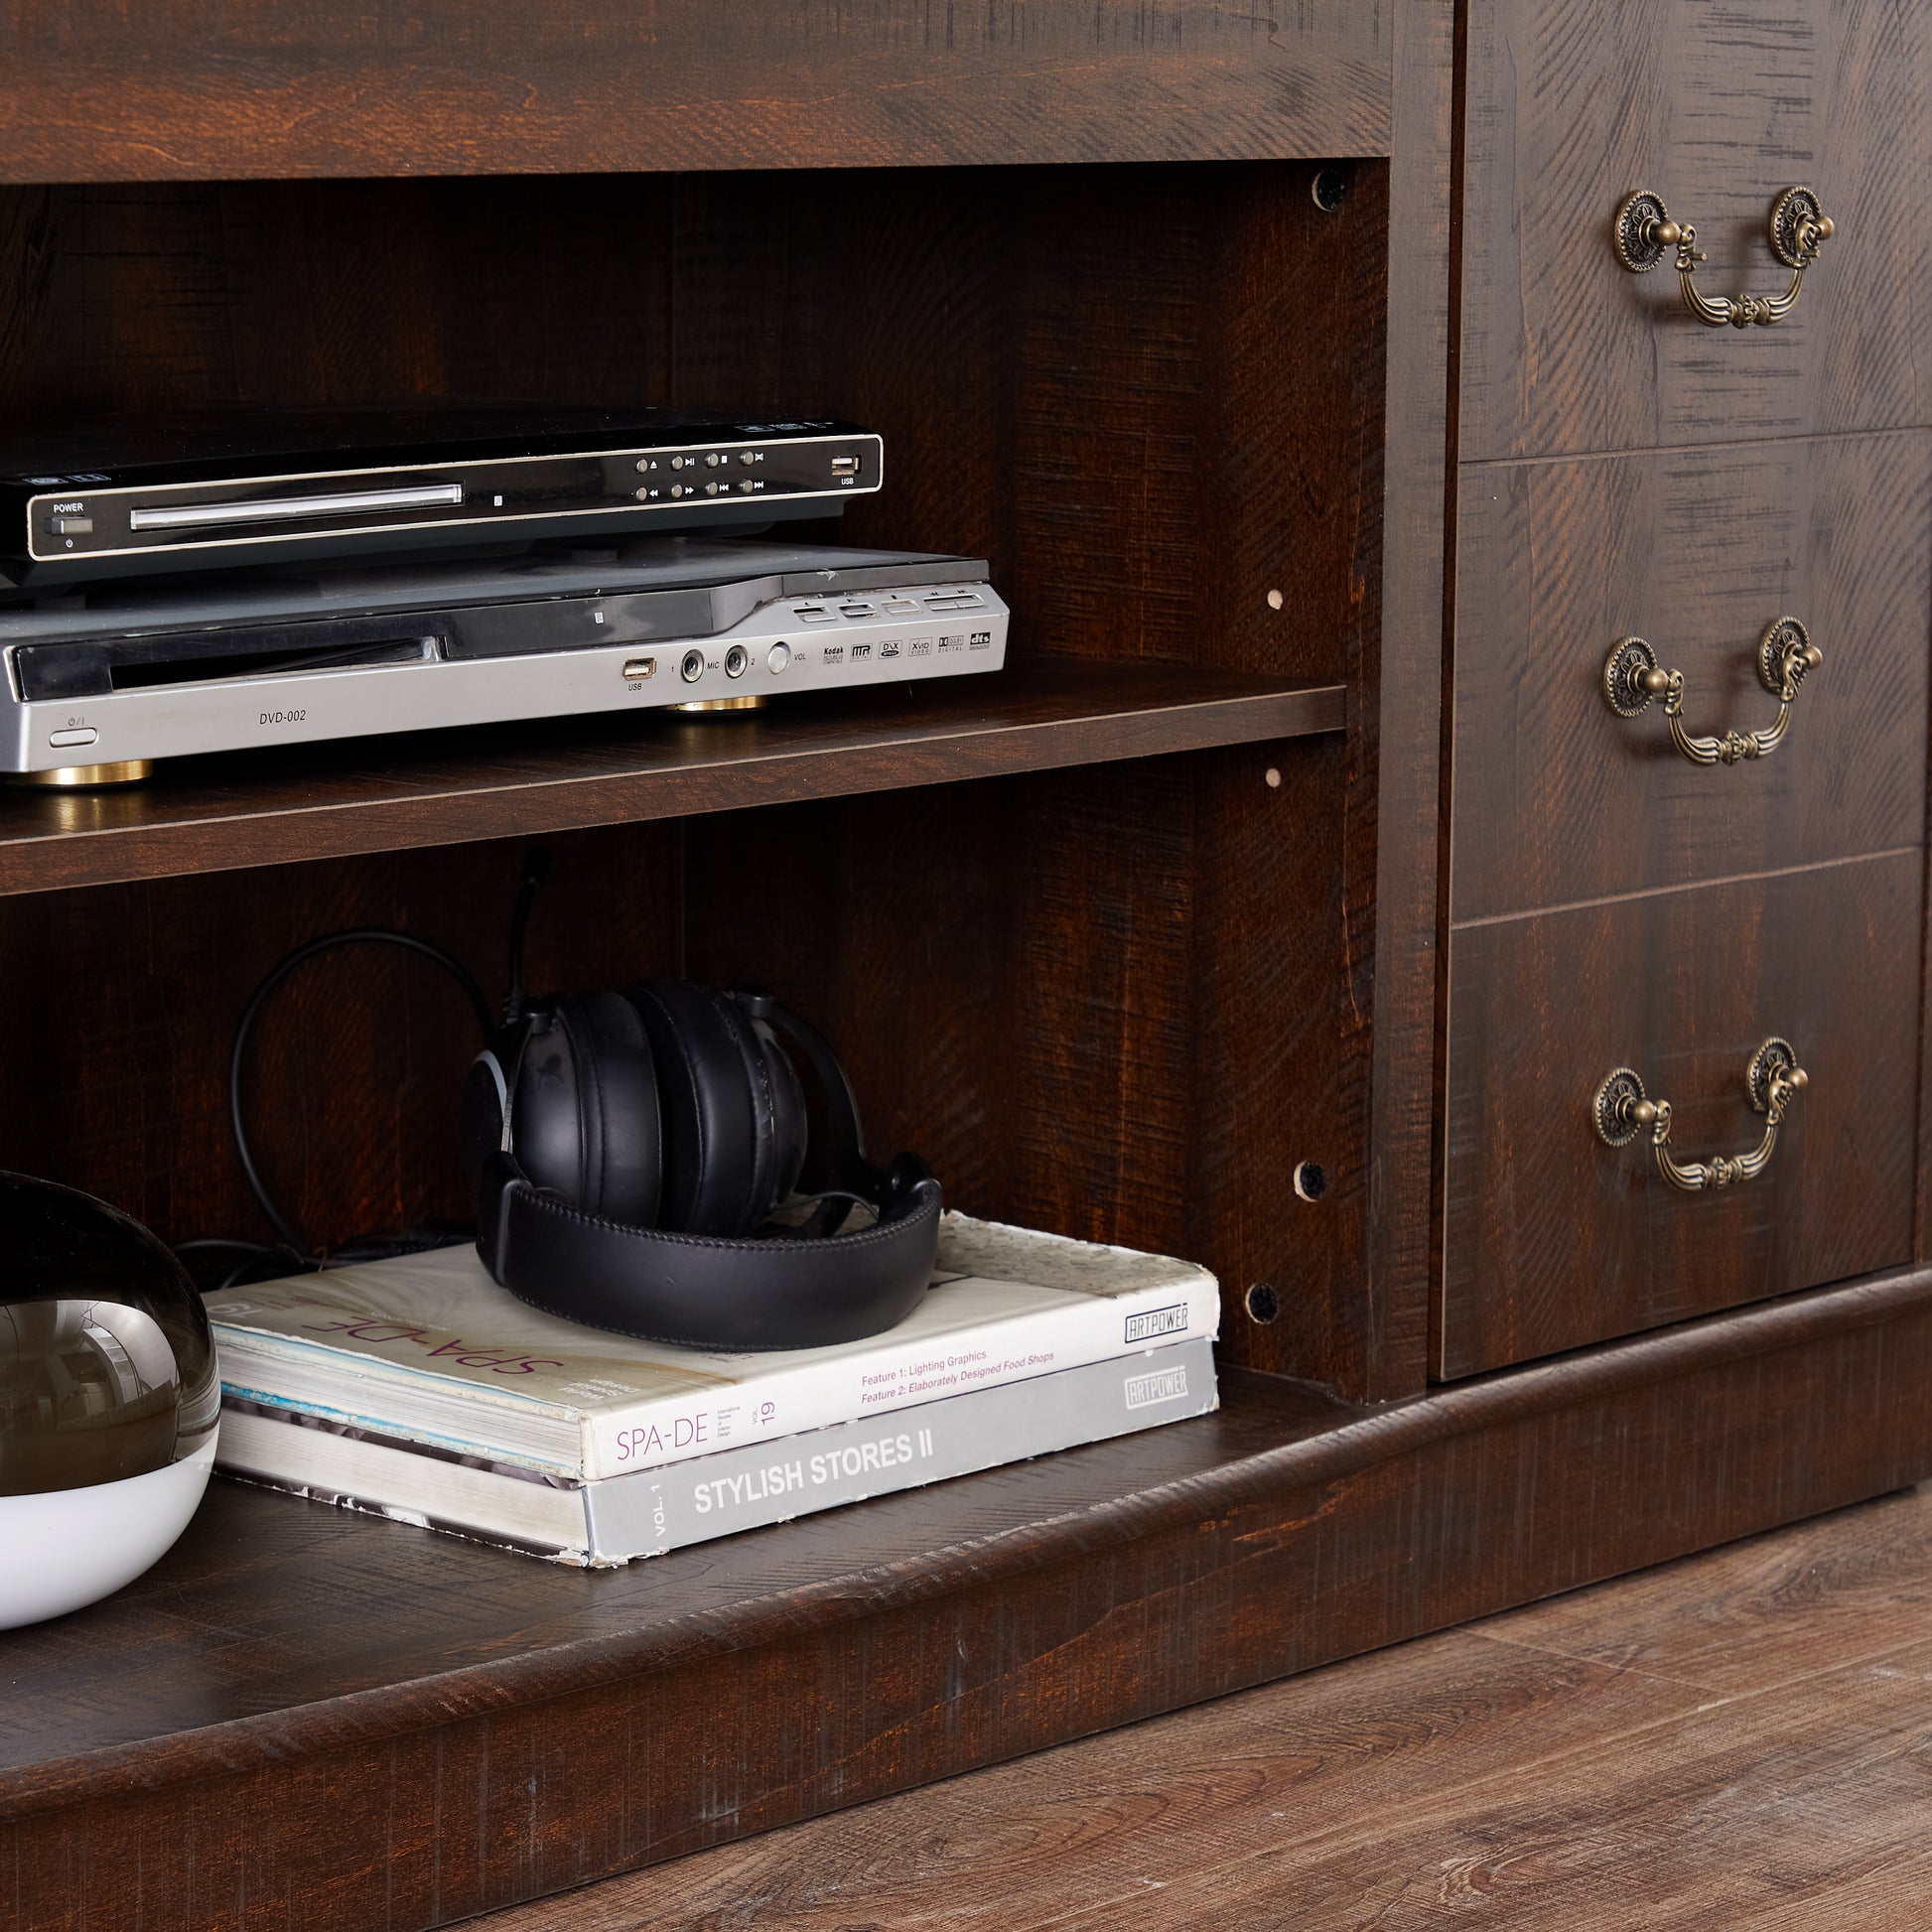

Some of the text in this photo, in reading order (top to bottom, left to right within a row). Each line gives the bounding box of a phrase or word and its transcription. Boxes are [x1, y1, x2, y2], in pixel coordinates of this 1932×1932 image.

[53, 502, 84, 513] POWER
[823, 645, 844, 655] Kodak
[971, 633, 989, 644] dts
[794, 652, 806, 661] VOL
[627, 682, 642, 692] USB
[259, 709, 307, 725] DVD-002
[1129, 1307, 1188, 1338] ARTPOWER
[301, 1315, 564, 1376] SPA-DE
[862, 1350, 987, 1387] Feature 1: Lighting Graphics
[862, 1352, 1054, 1405] Feature 2: Elaborately Designed Food Shops
[1129, 1371, 1188, 1404] ARTPOWER
[760, 1402, 775, 1427] 19
[617, 1413, 708, 1460] SPA-DE
[695, 1429, 933, 1514] STYLISH STORES II
[653, 1495, 666, 1537] VOL.
